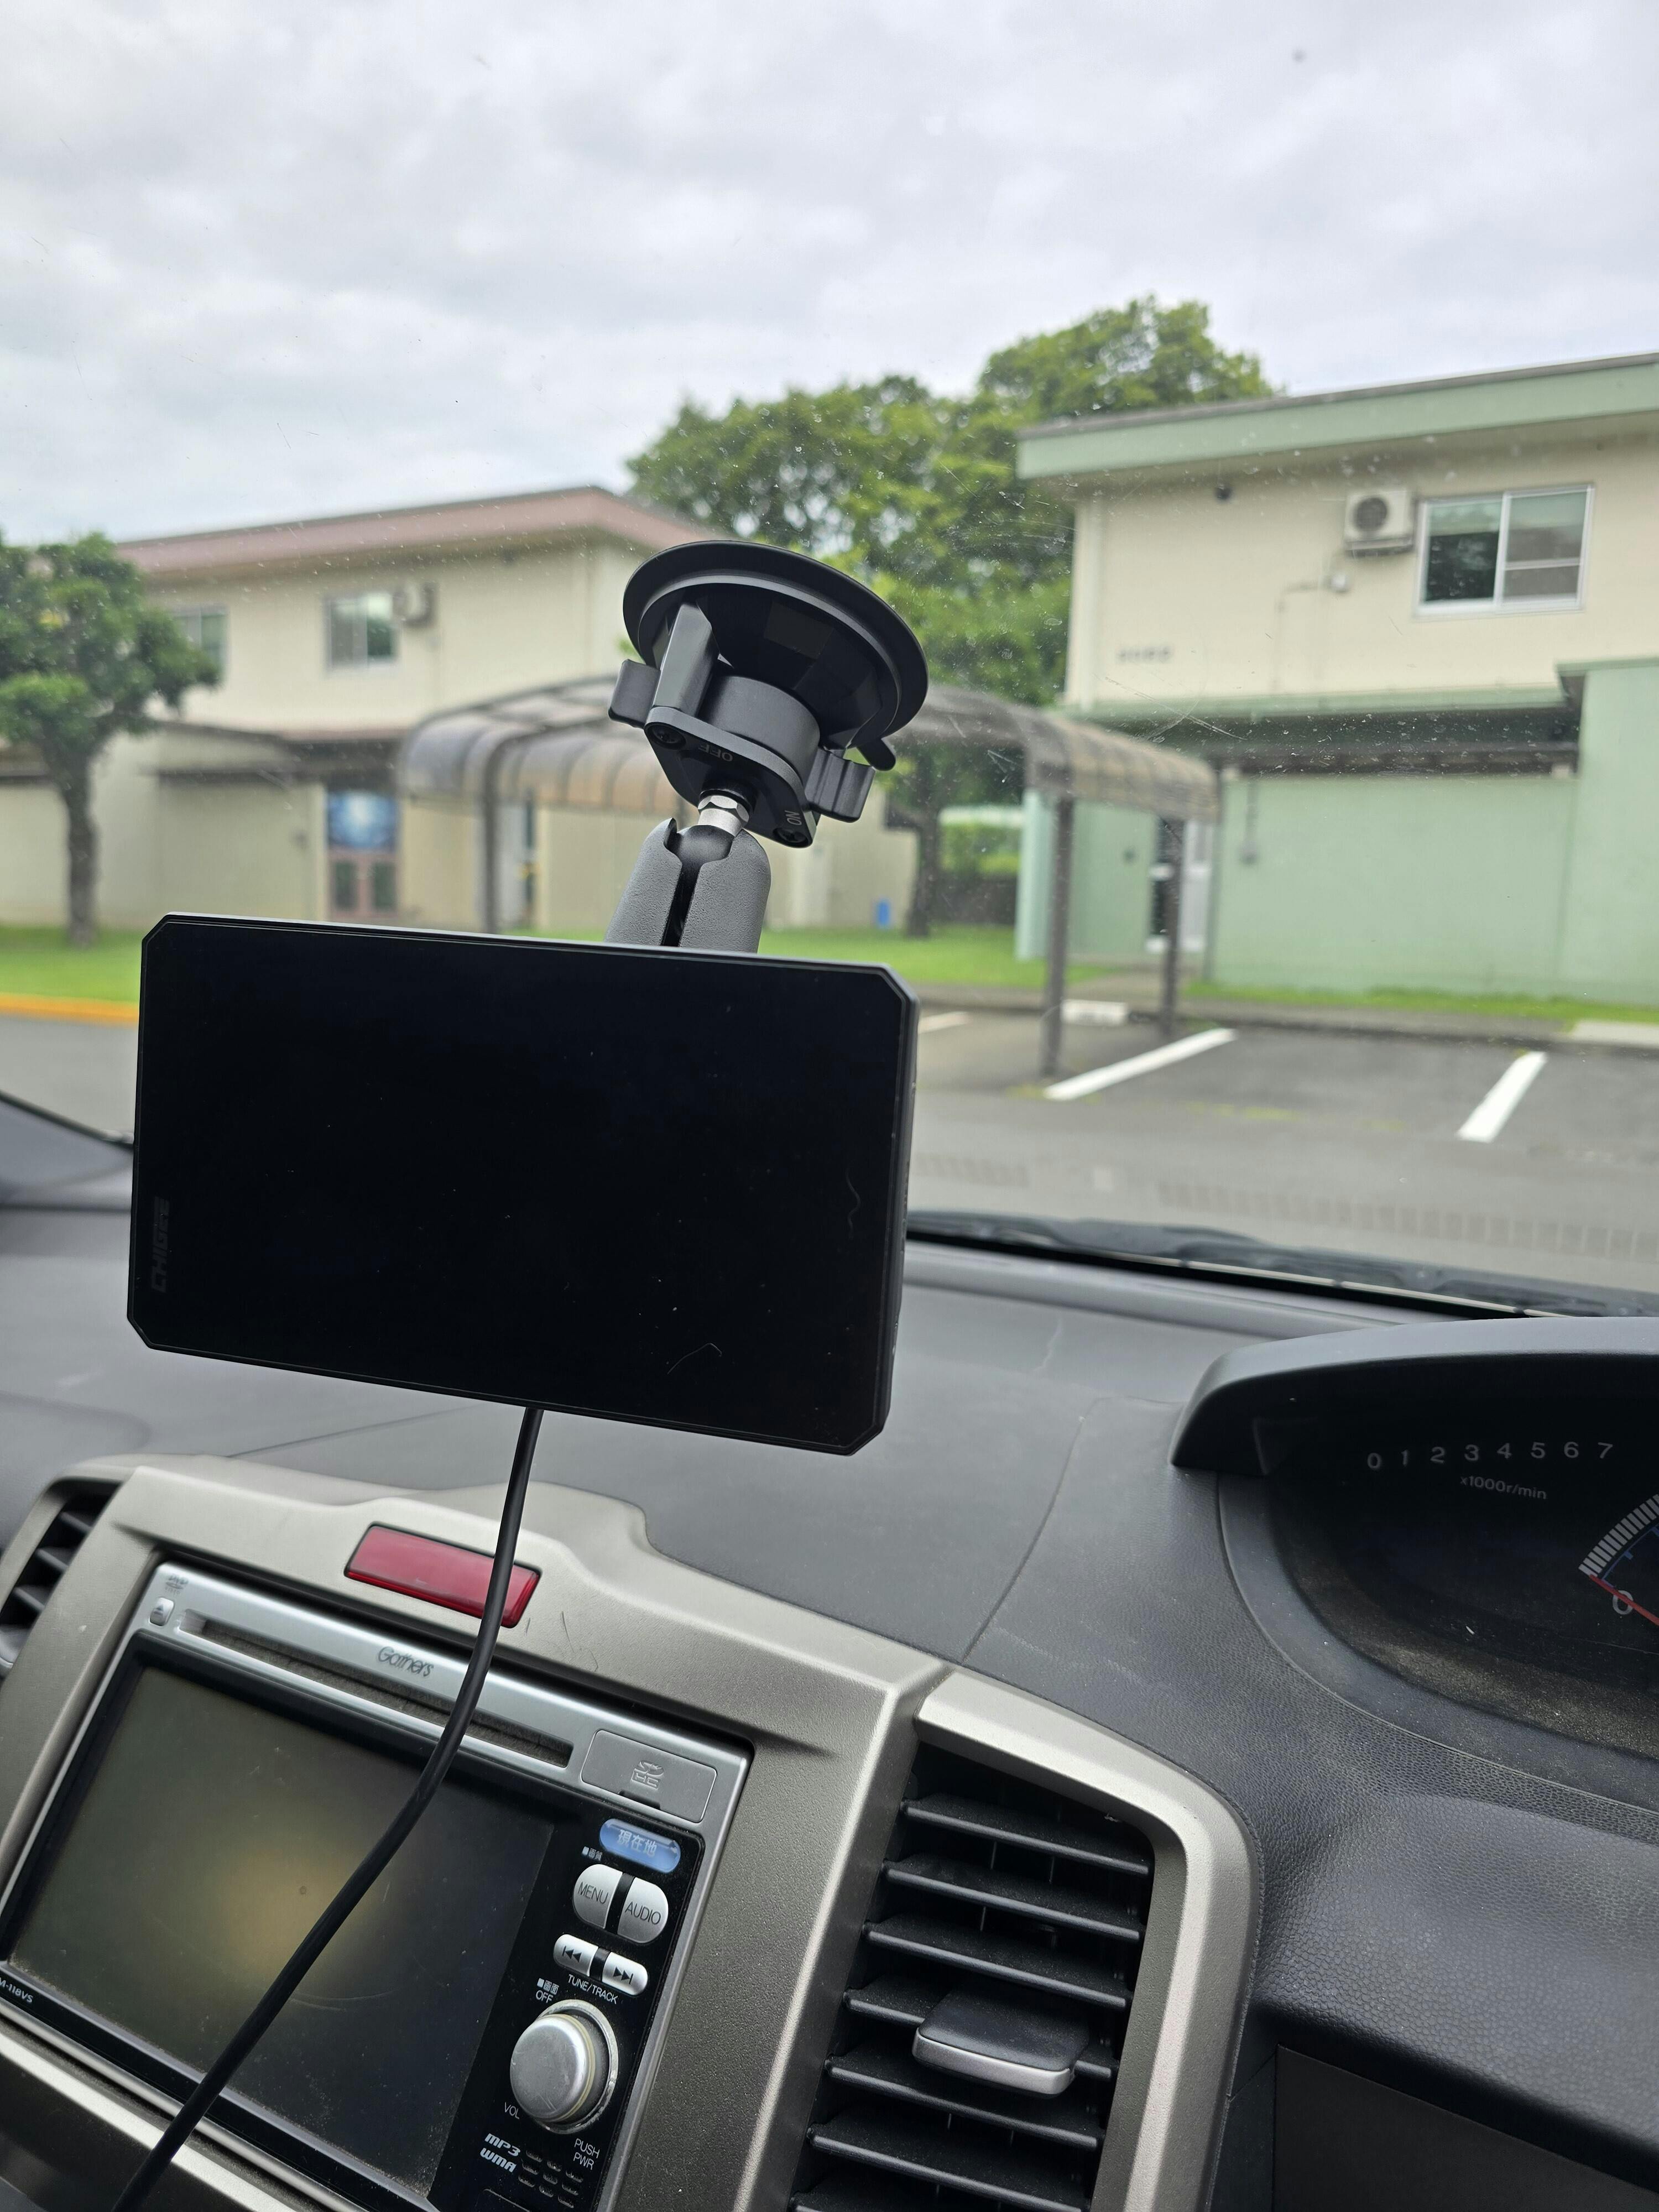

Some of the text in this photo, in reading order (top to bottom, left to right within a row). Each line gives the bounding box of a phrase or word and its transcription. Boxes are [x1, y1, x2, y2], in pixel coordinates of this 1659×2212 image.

[698, 744, 733, 762] OFF
[784, 810, 802, 825] ON
[150, 1196, 170, 1293] CHIGEE
[1367, 1441, 1614, 1469] 0 1 2 3 4 5 6 7
[1613, 1590, 1634, 1615] 0
[617, 1829, 658, 1858] 現在地
[578, 1881, 608, 1905] MENU
[624, 1901, 661, 1925] AUDIO
[535, 1990, 554, 2003] OFF
[568, 1974, 618, 2005] TUNE/TRACK
[504, 2102, 520, 2120] VOL
[484, 2133, 521, 2157] MP3
[574, 2138, 600, 2159] PUSH
[479, 2147, 517, 2173] WMA
[573, 2152, 594, 2171] PWR
